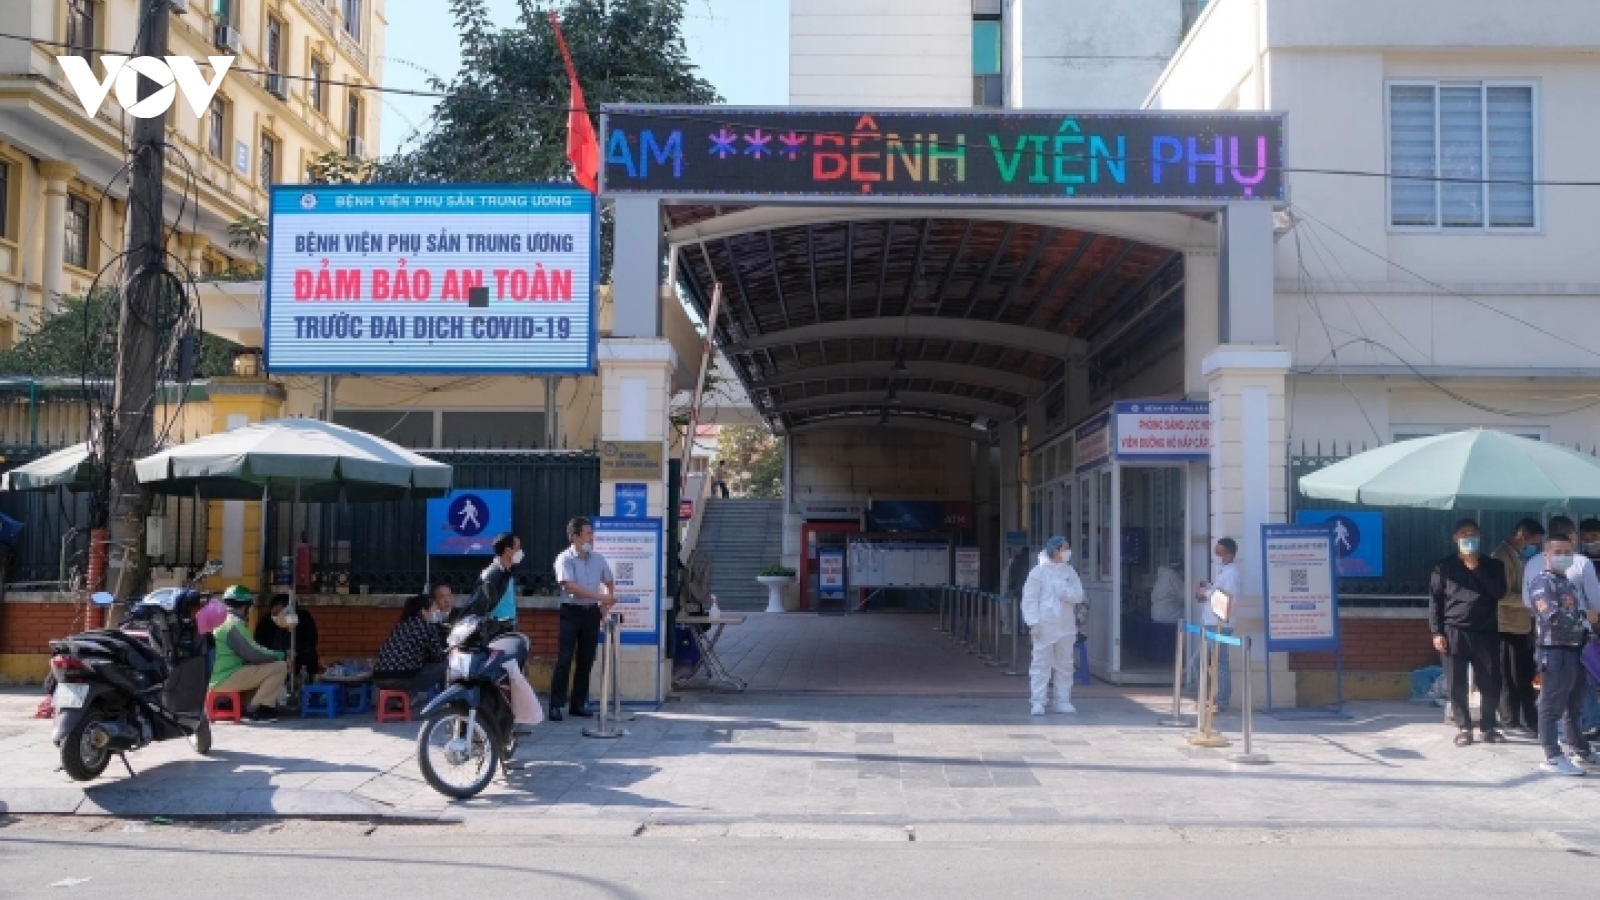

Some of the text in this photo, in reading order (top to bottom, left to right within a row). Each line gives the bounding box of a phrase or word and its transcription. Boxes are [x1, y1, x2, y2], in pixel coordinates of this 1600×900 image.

[812, 114, 965, 193] BỆNH
[988, 117, 1125, 195] VIỆN
[1152, 134, 1267, 195] PHỤ
[335, 192, 572, 208] BỆNH VIỆN PHỤ SẢN TRUNG ƯƠNG
[295, 227, 574, 257] BỆNH VIỆN PHỤ SẢN TRUNG ƯƠNG
[293, 258, 572, 302] ĐẢM BẢO AN TOÀN
[295, 311, 571, 345] TRƯỚC ĐẠI DỊCH COVID-19
[624, 500, 637, 517] 2
